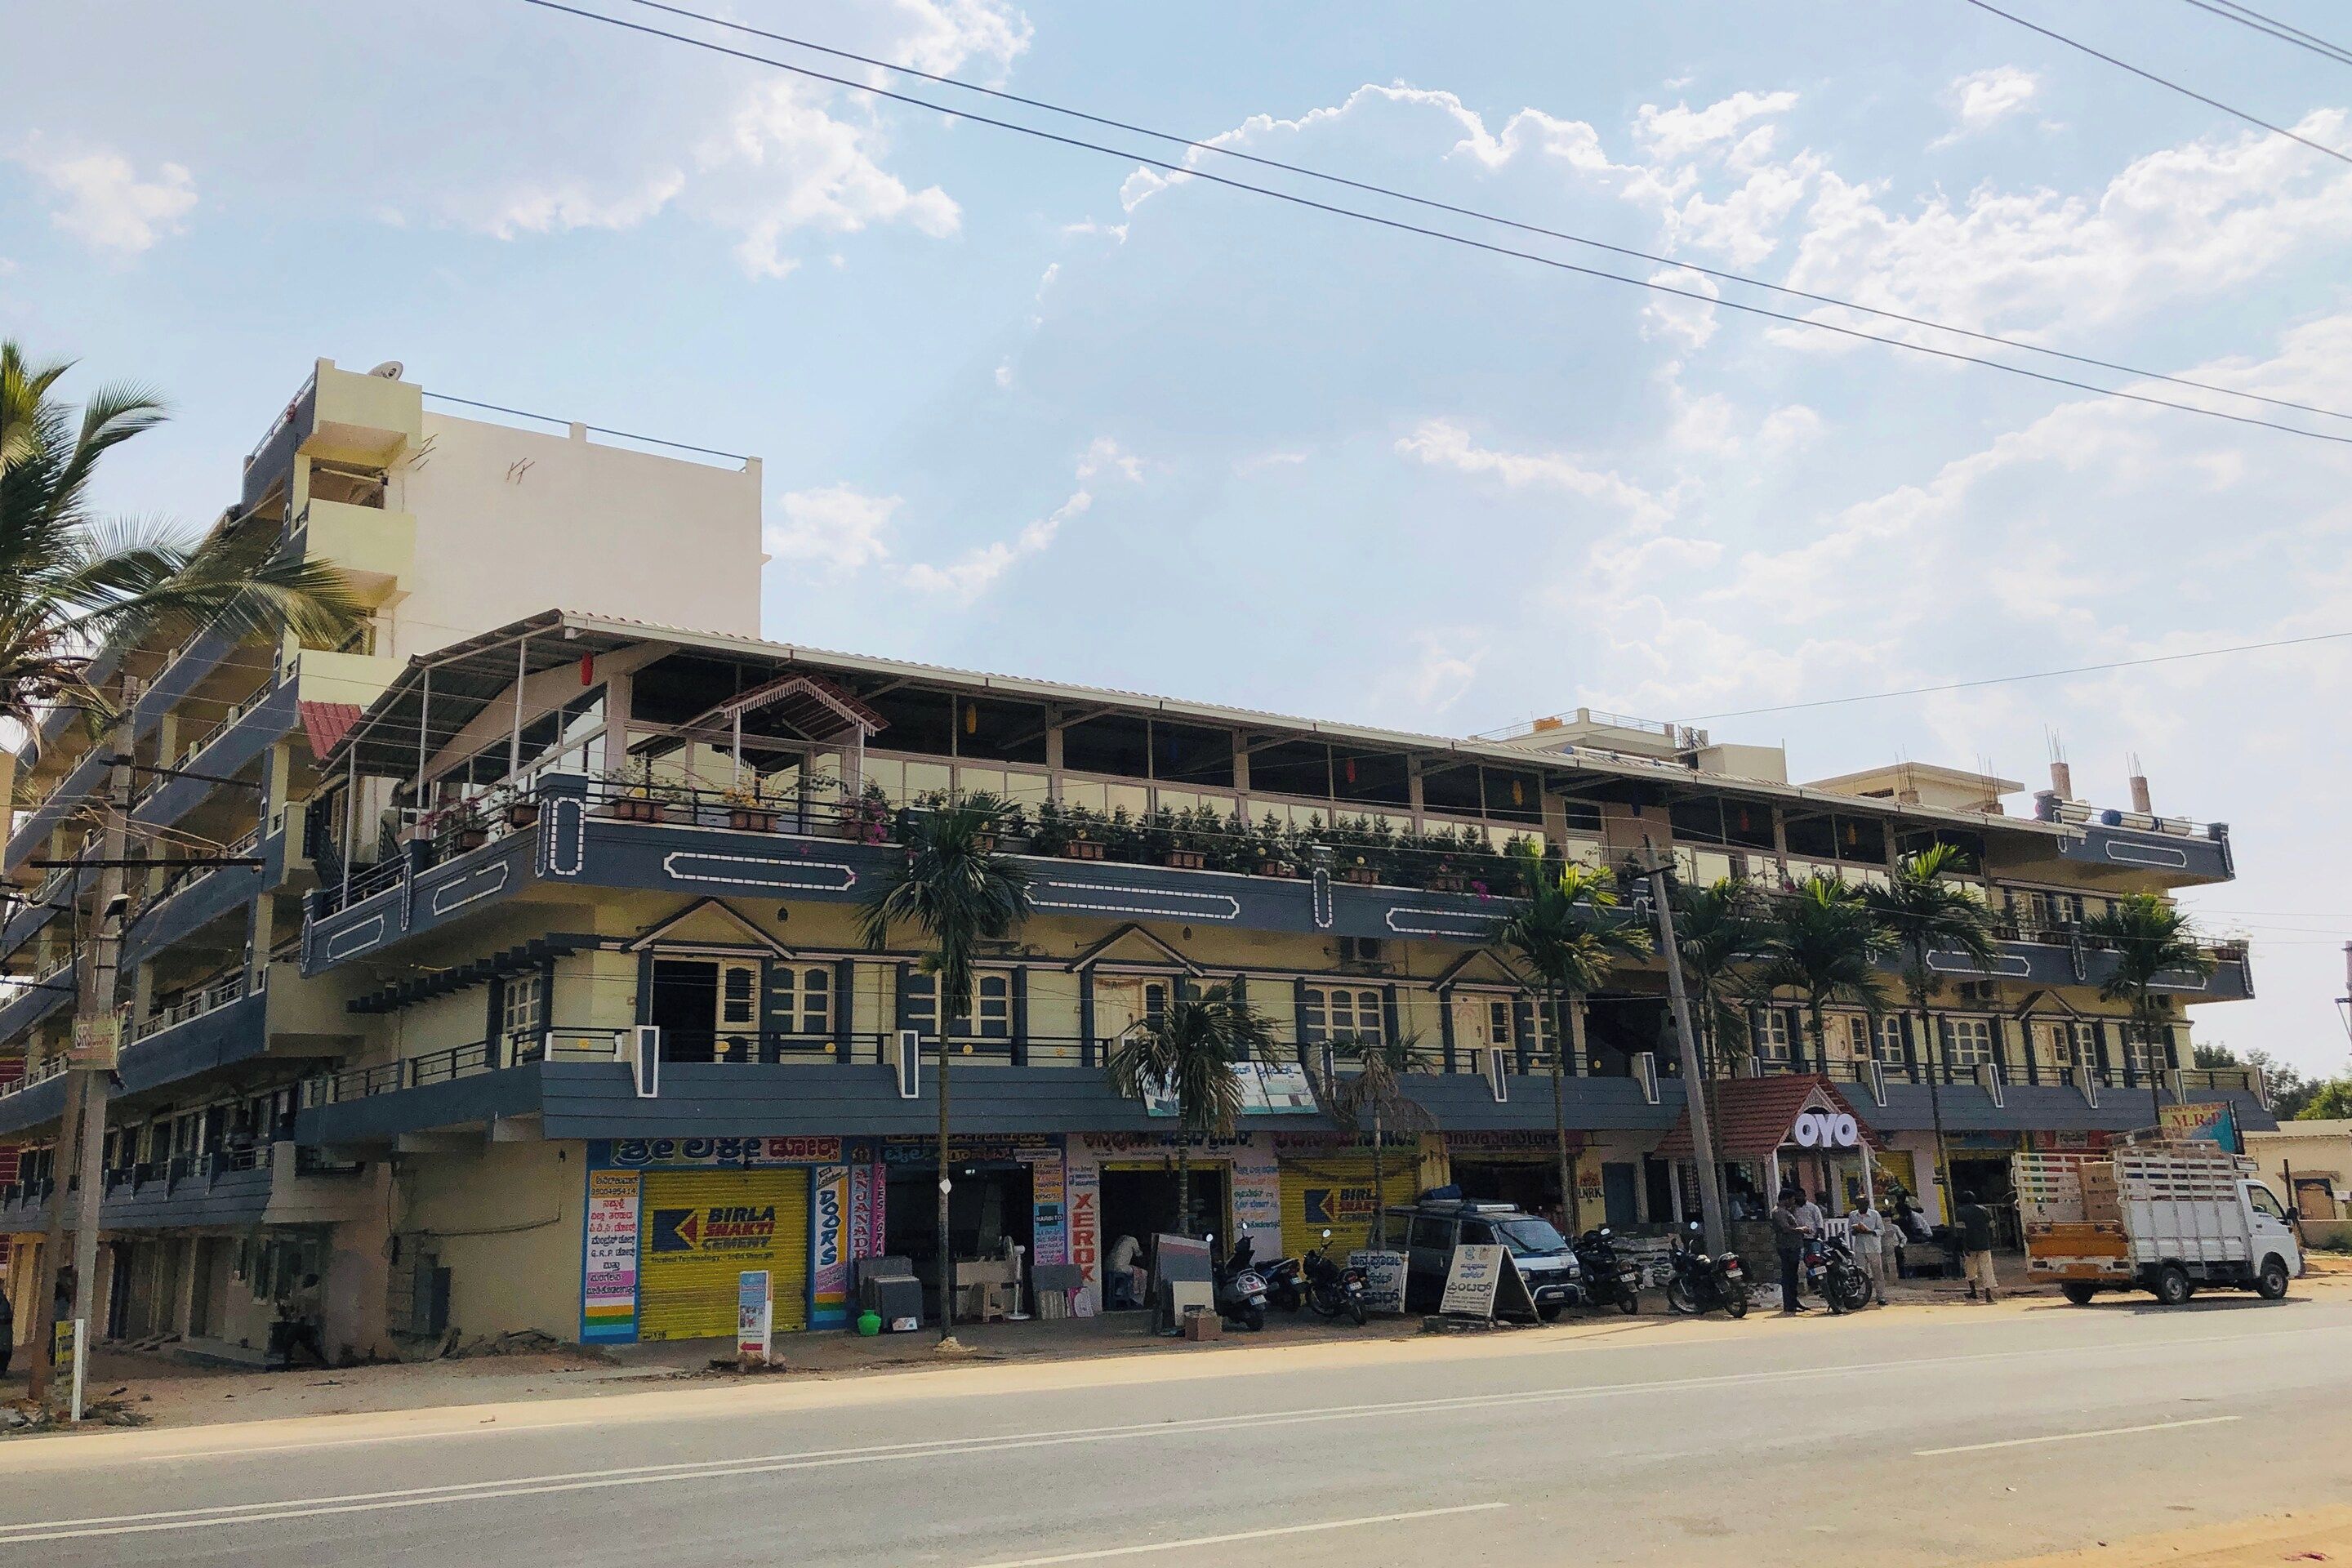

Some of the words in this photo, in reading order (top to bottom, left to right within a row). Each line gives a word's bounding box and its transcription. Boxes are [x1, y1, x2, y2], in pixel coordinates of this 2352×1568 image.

[1796, 1113, 1858, 1147] OYO
[704, 1221, 775, 1237] SHAKTI
[708, 1205, 776, 1223] BIRLA
[819, 1189, 841, 1266] DOORS
[1073, 1192, 1095, 1281] XEROX
